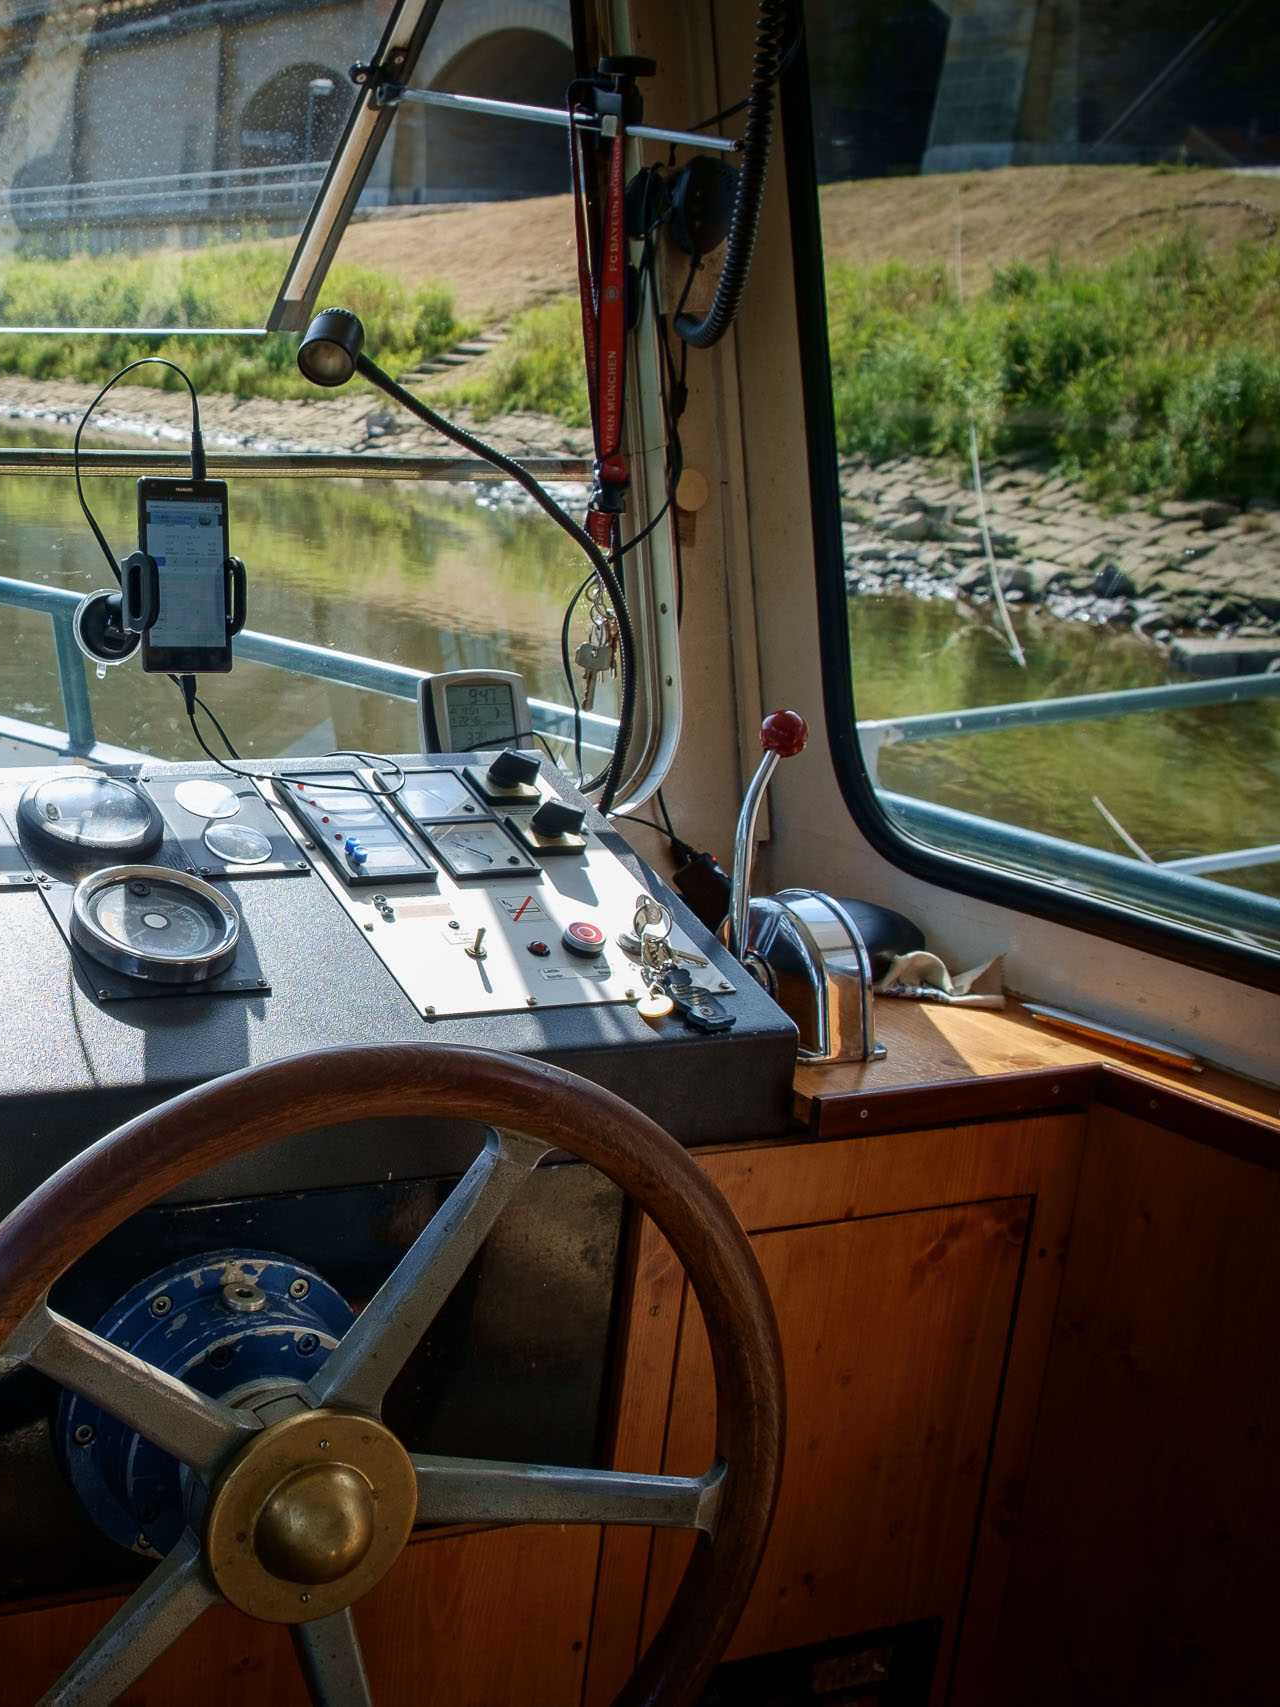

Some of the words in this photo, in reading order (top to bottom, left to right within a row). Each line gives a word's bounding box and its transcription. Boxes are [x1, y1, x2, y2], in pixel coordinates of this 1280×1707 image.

[609, 200, 620, 254] BAYERN
[609, 255, 618, 272] FC
[607, 350, 617, 413] MÜNCHEN
